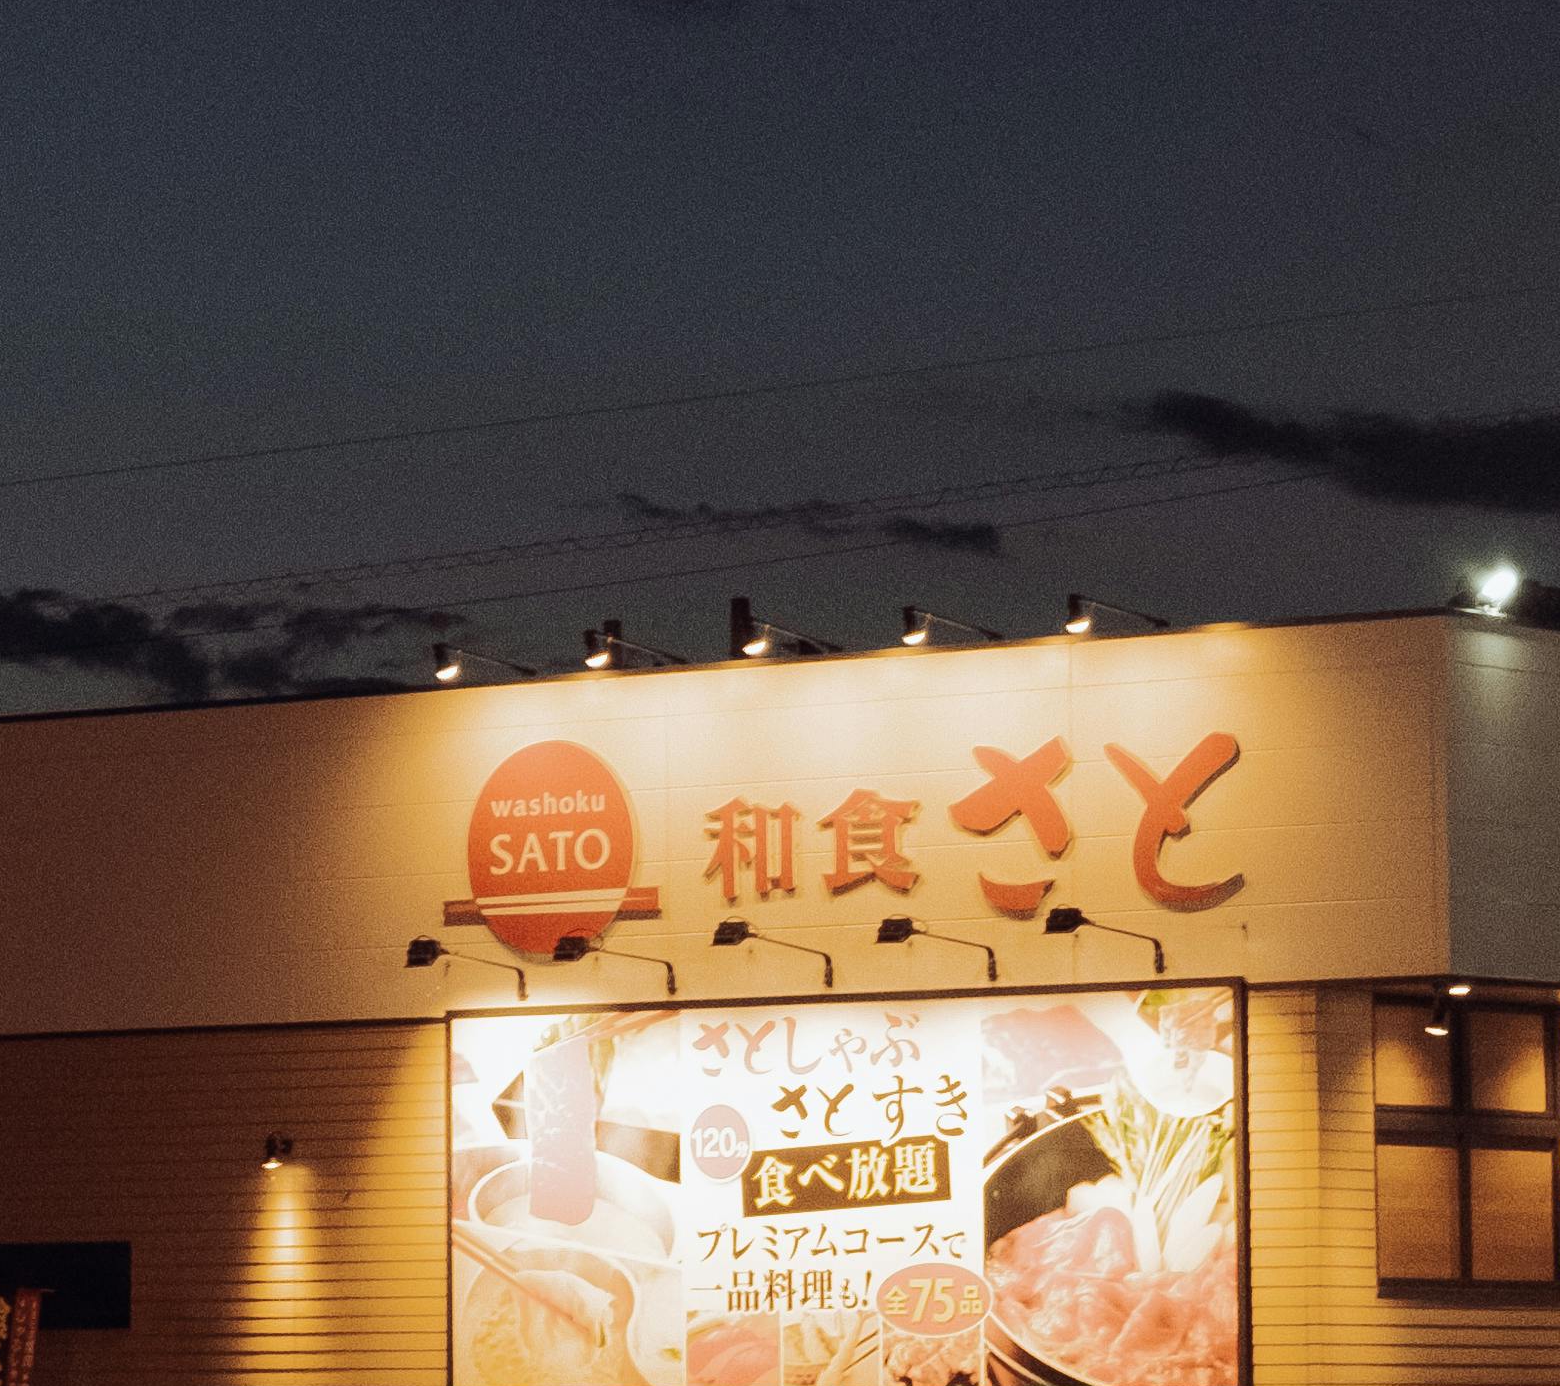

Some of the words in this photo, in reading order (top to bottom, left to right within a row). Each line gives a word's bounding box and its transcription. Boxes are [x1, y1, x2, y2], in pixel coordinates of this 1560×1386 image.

[490, 789, 605, 818] washoku
[490, 827, 611, 876] SATO
[691, 1011, 921, 1078] さとしゃぶ
[771, 1074, 968, 1141] さとすき
[751, 1141, 938, 1210] 食べ放題
[697, 1222, 966, 1262] プレミアムコースで
[883, 1277, 984, 1323] 全75品
